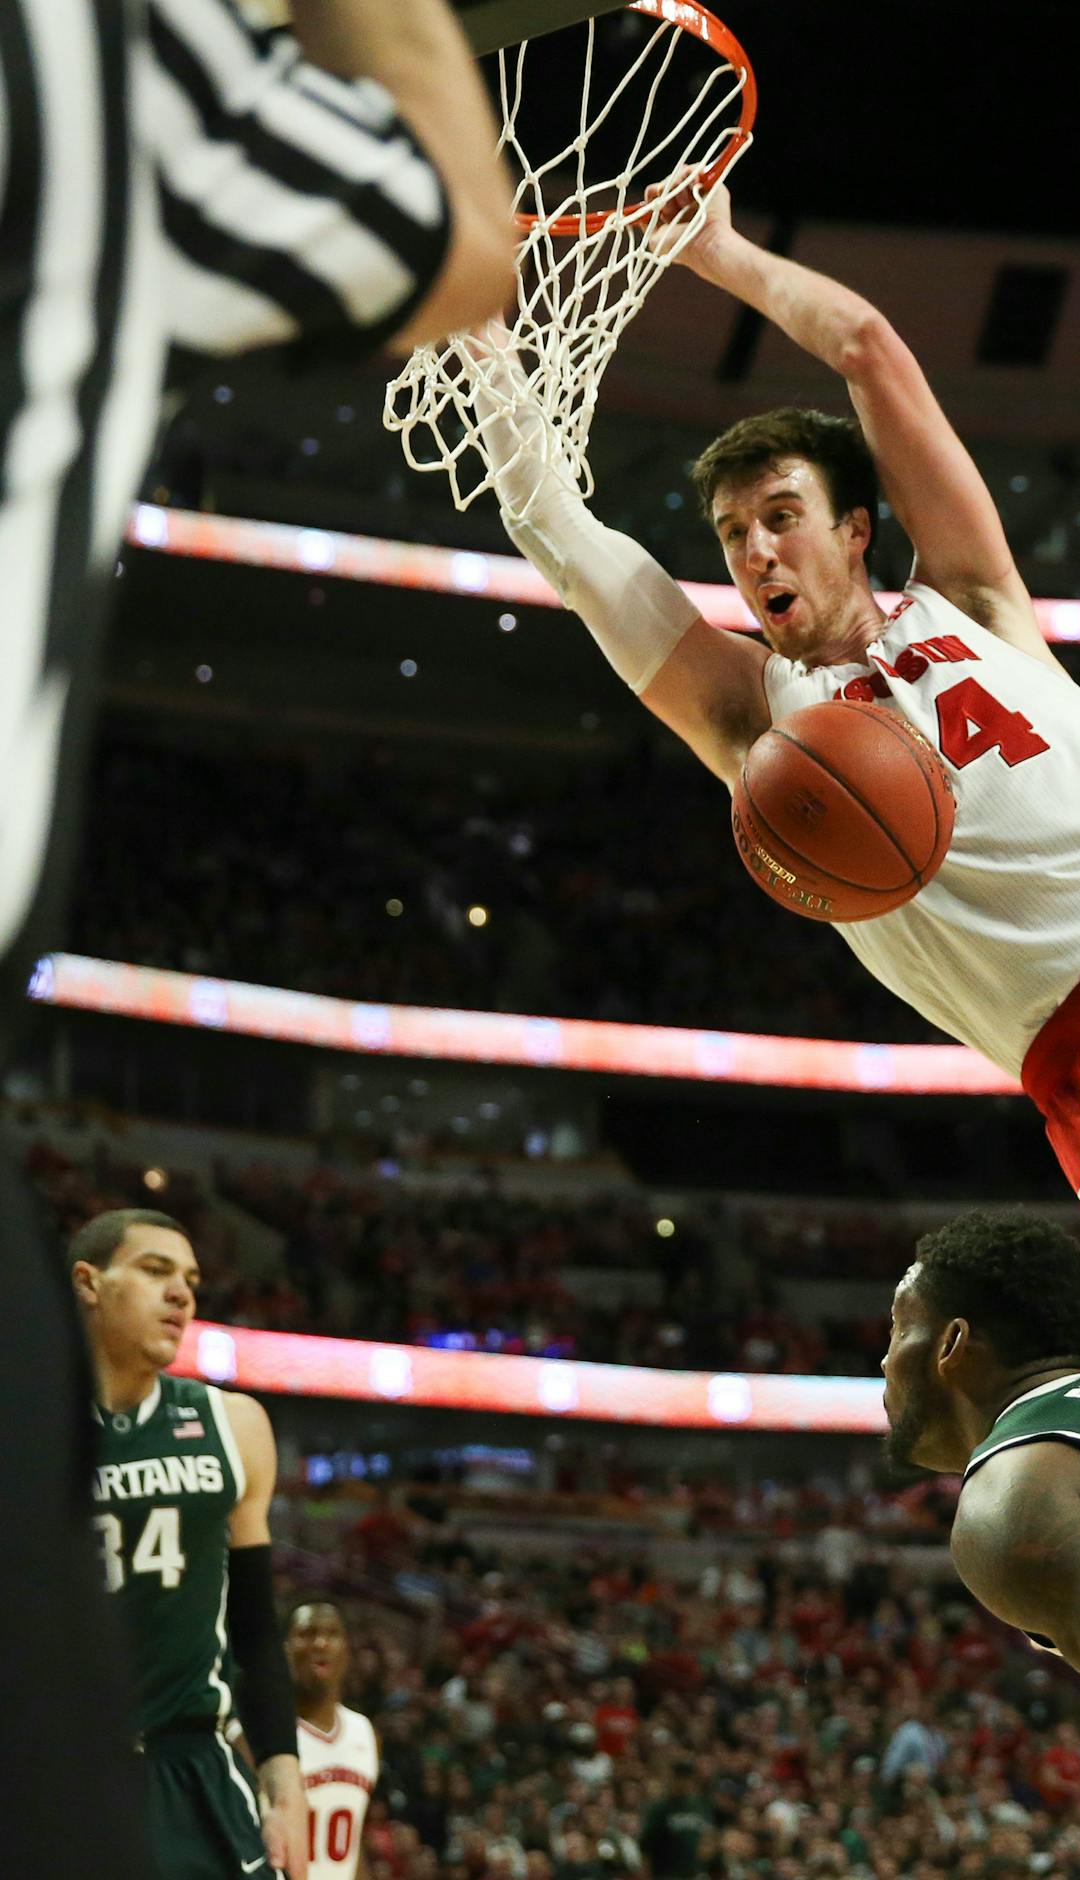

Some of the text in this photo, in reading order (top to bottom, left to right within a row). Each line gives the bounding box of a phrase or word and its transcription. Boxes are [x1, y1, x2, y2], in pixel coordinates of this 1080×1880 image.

[92, 1454, 224, 1501] RTANS
[92, 1506, 187, 1593] 34
[308, 1807, 354, 1863] 10
